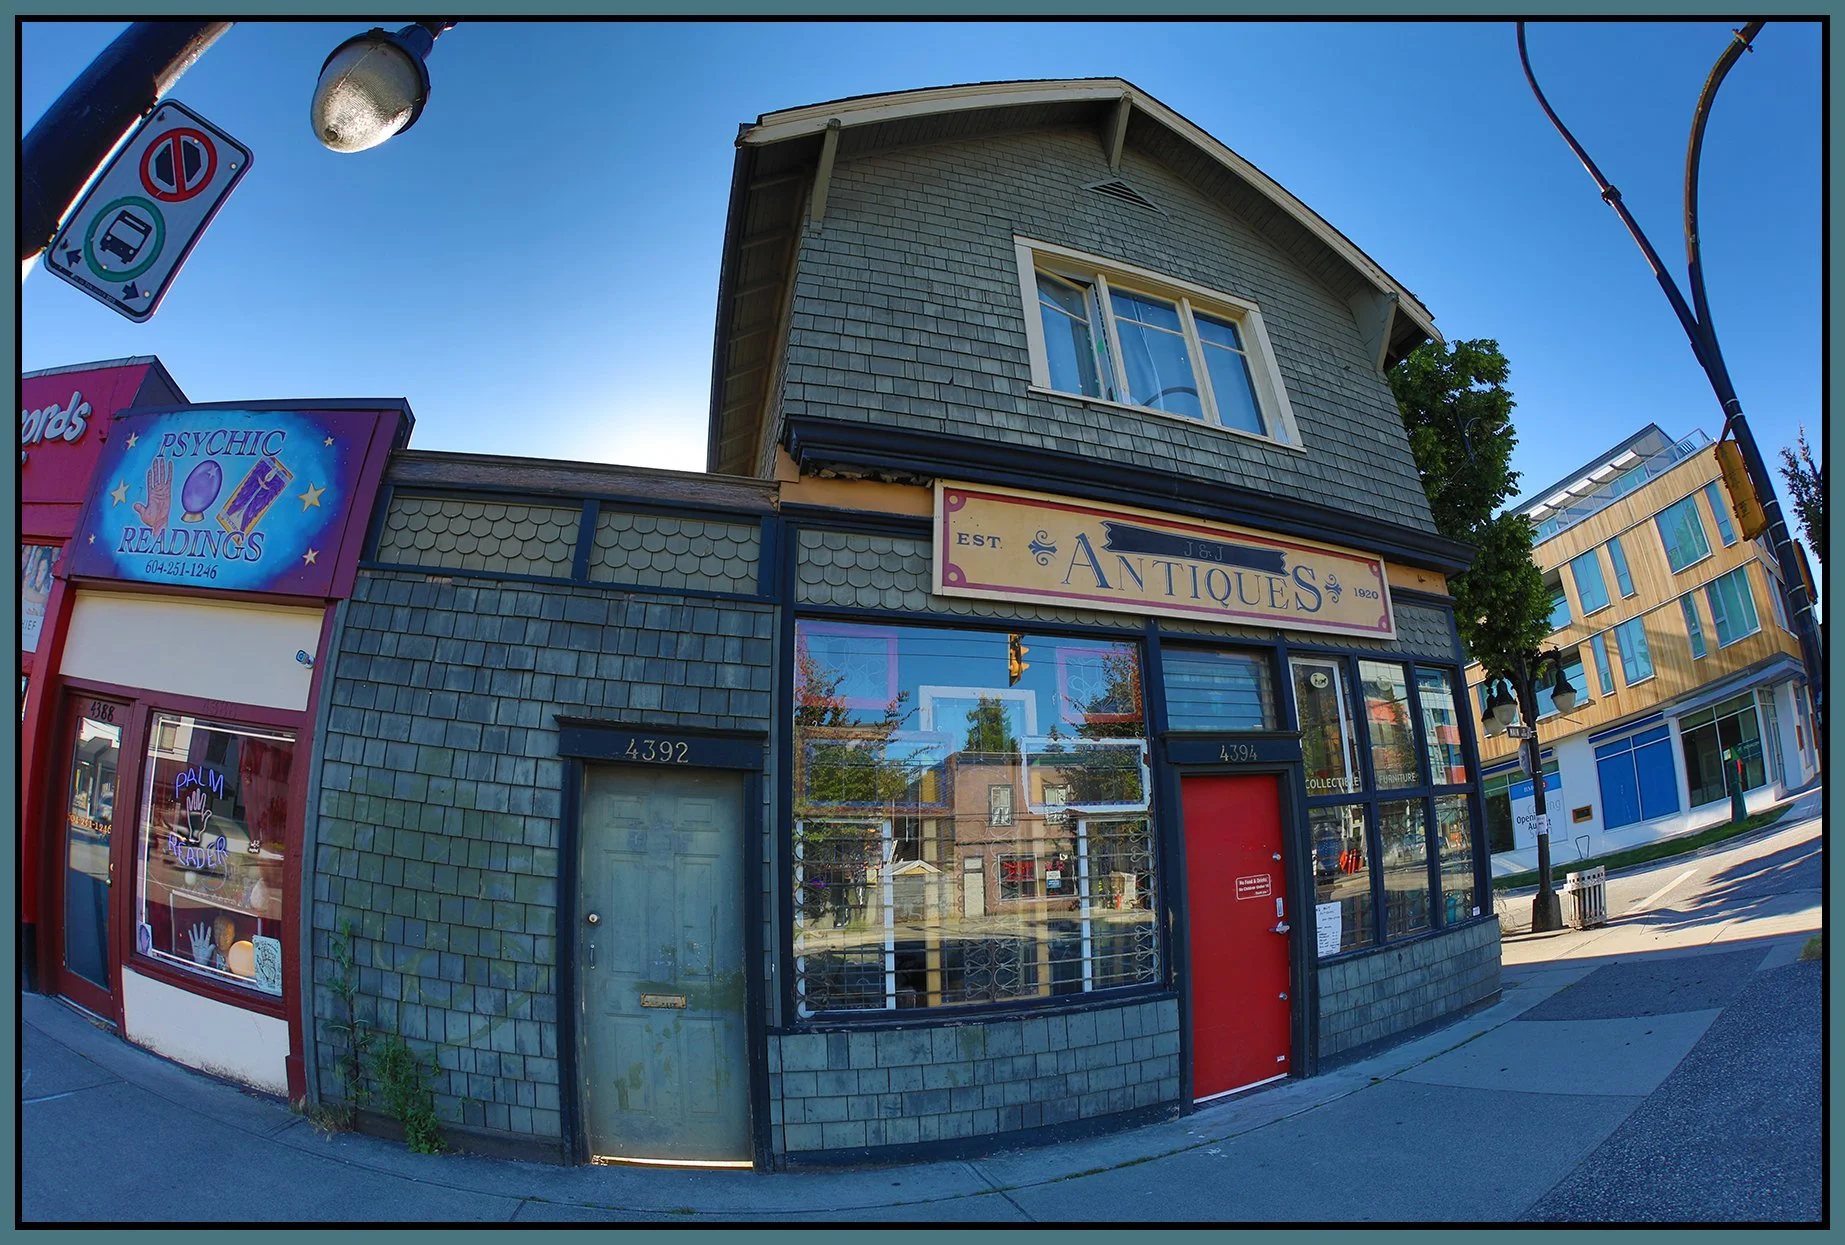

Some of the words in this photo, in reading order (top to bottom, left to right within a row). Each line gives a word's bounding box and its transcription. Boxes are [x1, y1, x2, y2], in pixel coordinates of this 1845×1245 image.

[156, 429, 287, 458] PSYCHIC
[117, 527, 265, 562] READINGS
[1183, 541, 1193, 557] J
[1199, 543, 1212, 559] &
[1214, 545, 1224, 561] J
[145, 559, 219, 579] 604-251-1246
[1061, 532, 1323, 613] ANTIQUES
[1353, 587, 1379, 600] 1920
[90, 701, 116, 724] 4388
[624, 738, 689, 763] 4392
[1219, 744, 1258, 762] 4394
[175, 766, 225, 800] PALM
[1378, 772, 1417, 785] FURNITURE
[168, 831, 230, 869] READER
